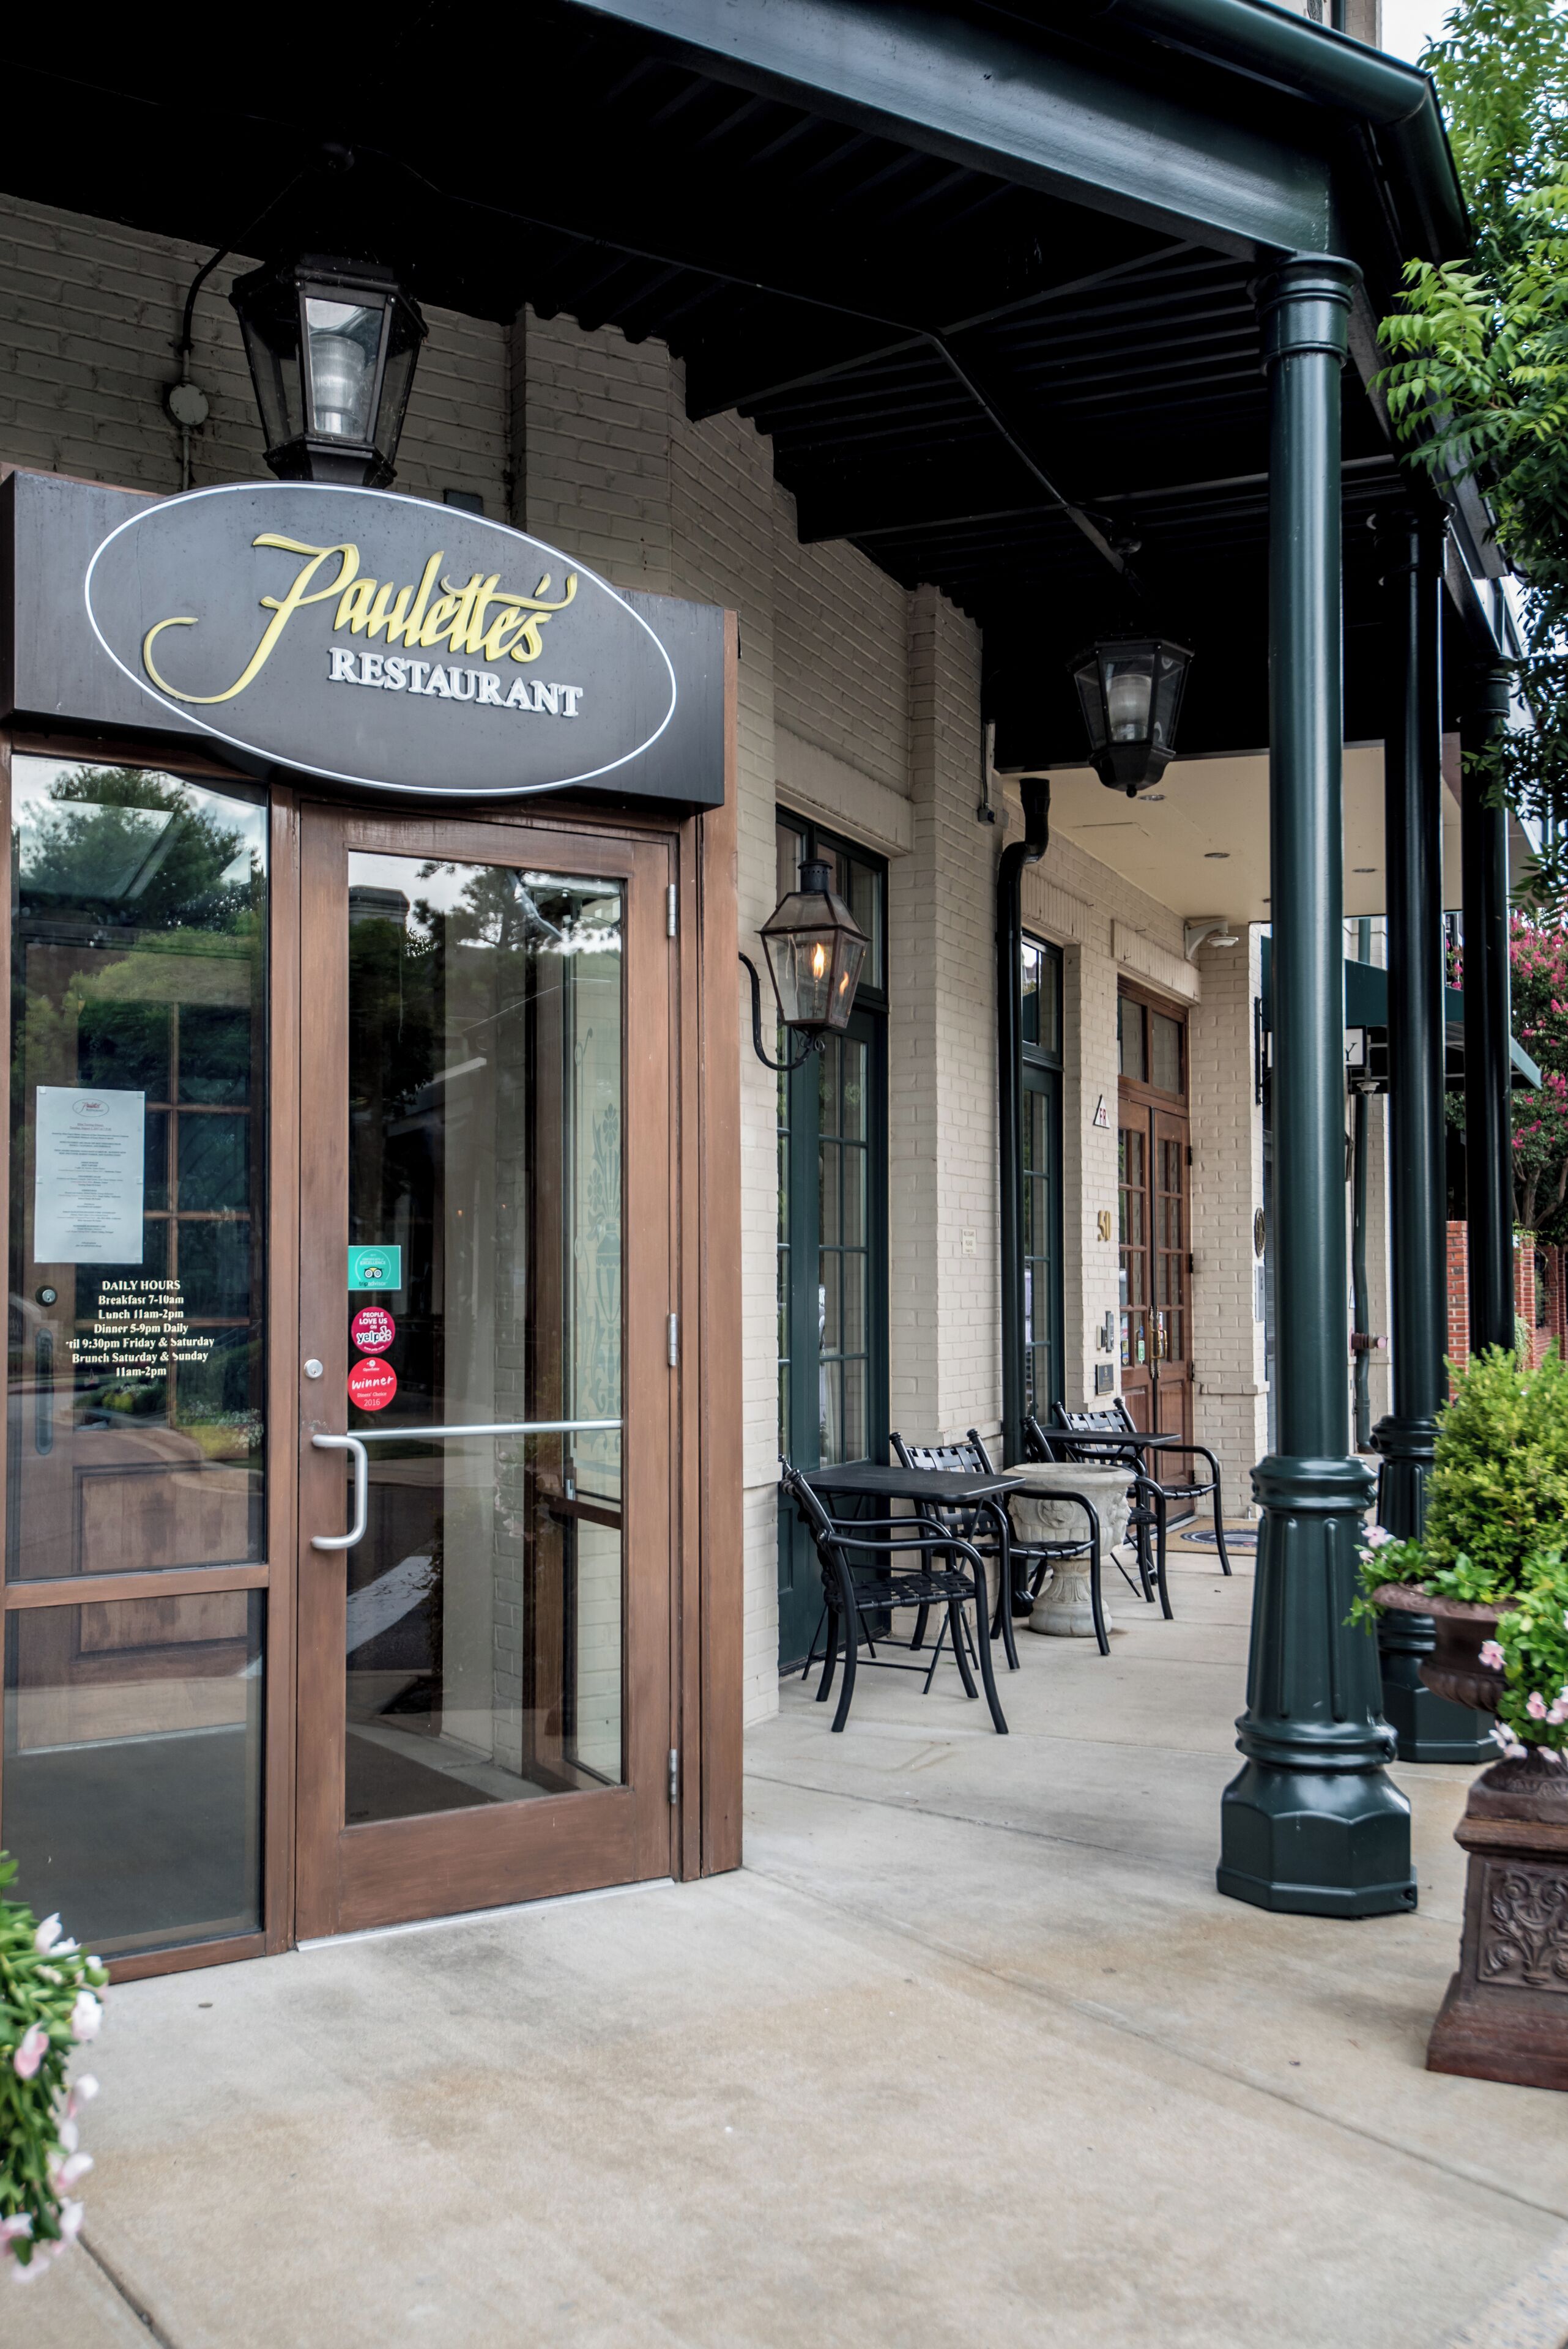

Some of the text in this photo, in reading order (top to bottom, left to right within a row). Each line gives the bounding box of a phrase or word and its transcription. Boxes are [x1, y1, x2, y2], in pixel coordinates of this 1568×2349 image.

[144, 533, 577, 705] Paulette's
[328, 647, 583, 718] RESTAURANT
[102, 1280, 181, 1290] DAILY HOURS
[148, 1294, 184, 1304] 7-10am
[98, 1309, 184, 1320] Lunch 11am-2pm
[94, 1323, 188, 1335] Dinner 5-9pm Daily
[82, 1338, 120, 1351] 9:30pm
[122, 1338, 156, 1349] Friday
[158, 1337, 168, 1346] &
[170, 1337, 215, 1348] Saturday
[357, 1330, 380, 1345] yelp
[72, 1351, 209, 1364] Brunch Saturday & Sunday
[116, 1367, 167, 1378] 11am-2pm
[352, 1376, 394, 1390] winner
